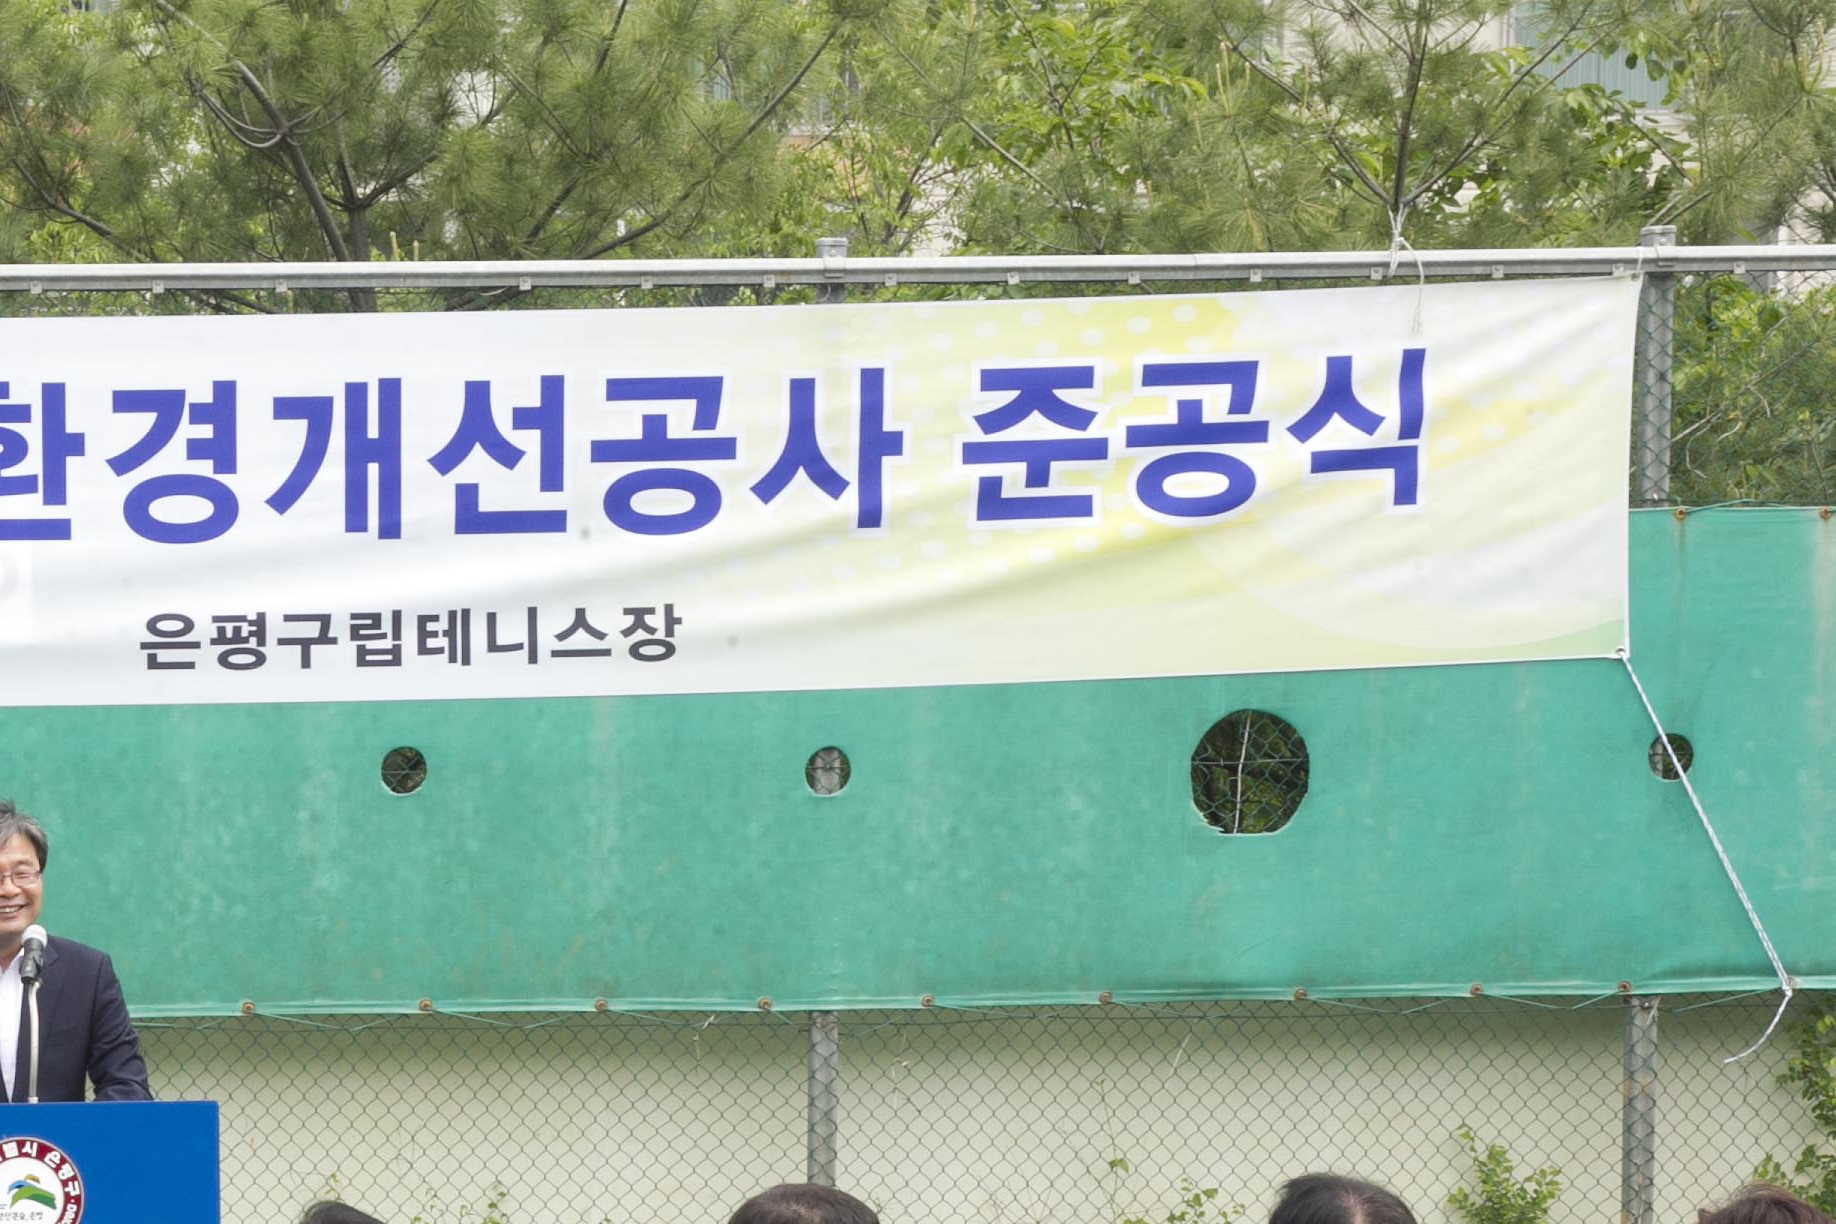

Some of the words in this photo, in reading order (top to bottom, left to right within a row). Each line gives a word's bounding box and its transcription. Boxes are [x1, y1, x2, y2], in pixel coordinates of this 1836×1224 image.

[961, 347, 1427, 521] 준공식
[139, 603, 683, 670] 은평구립테니스장
[44, 1151, 81, 1196] 은평구
